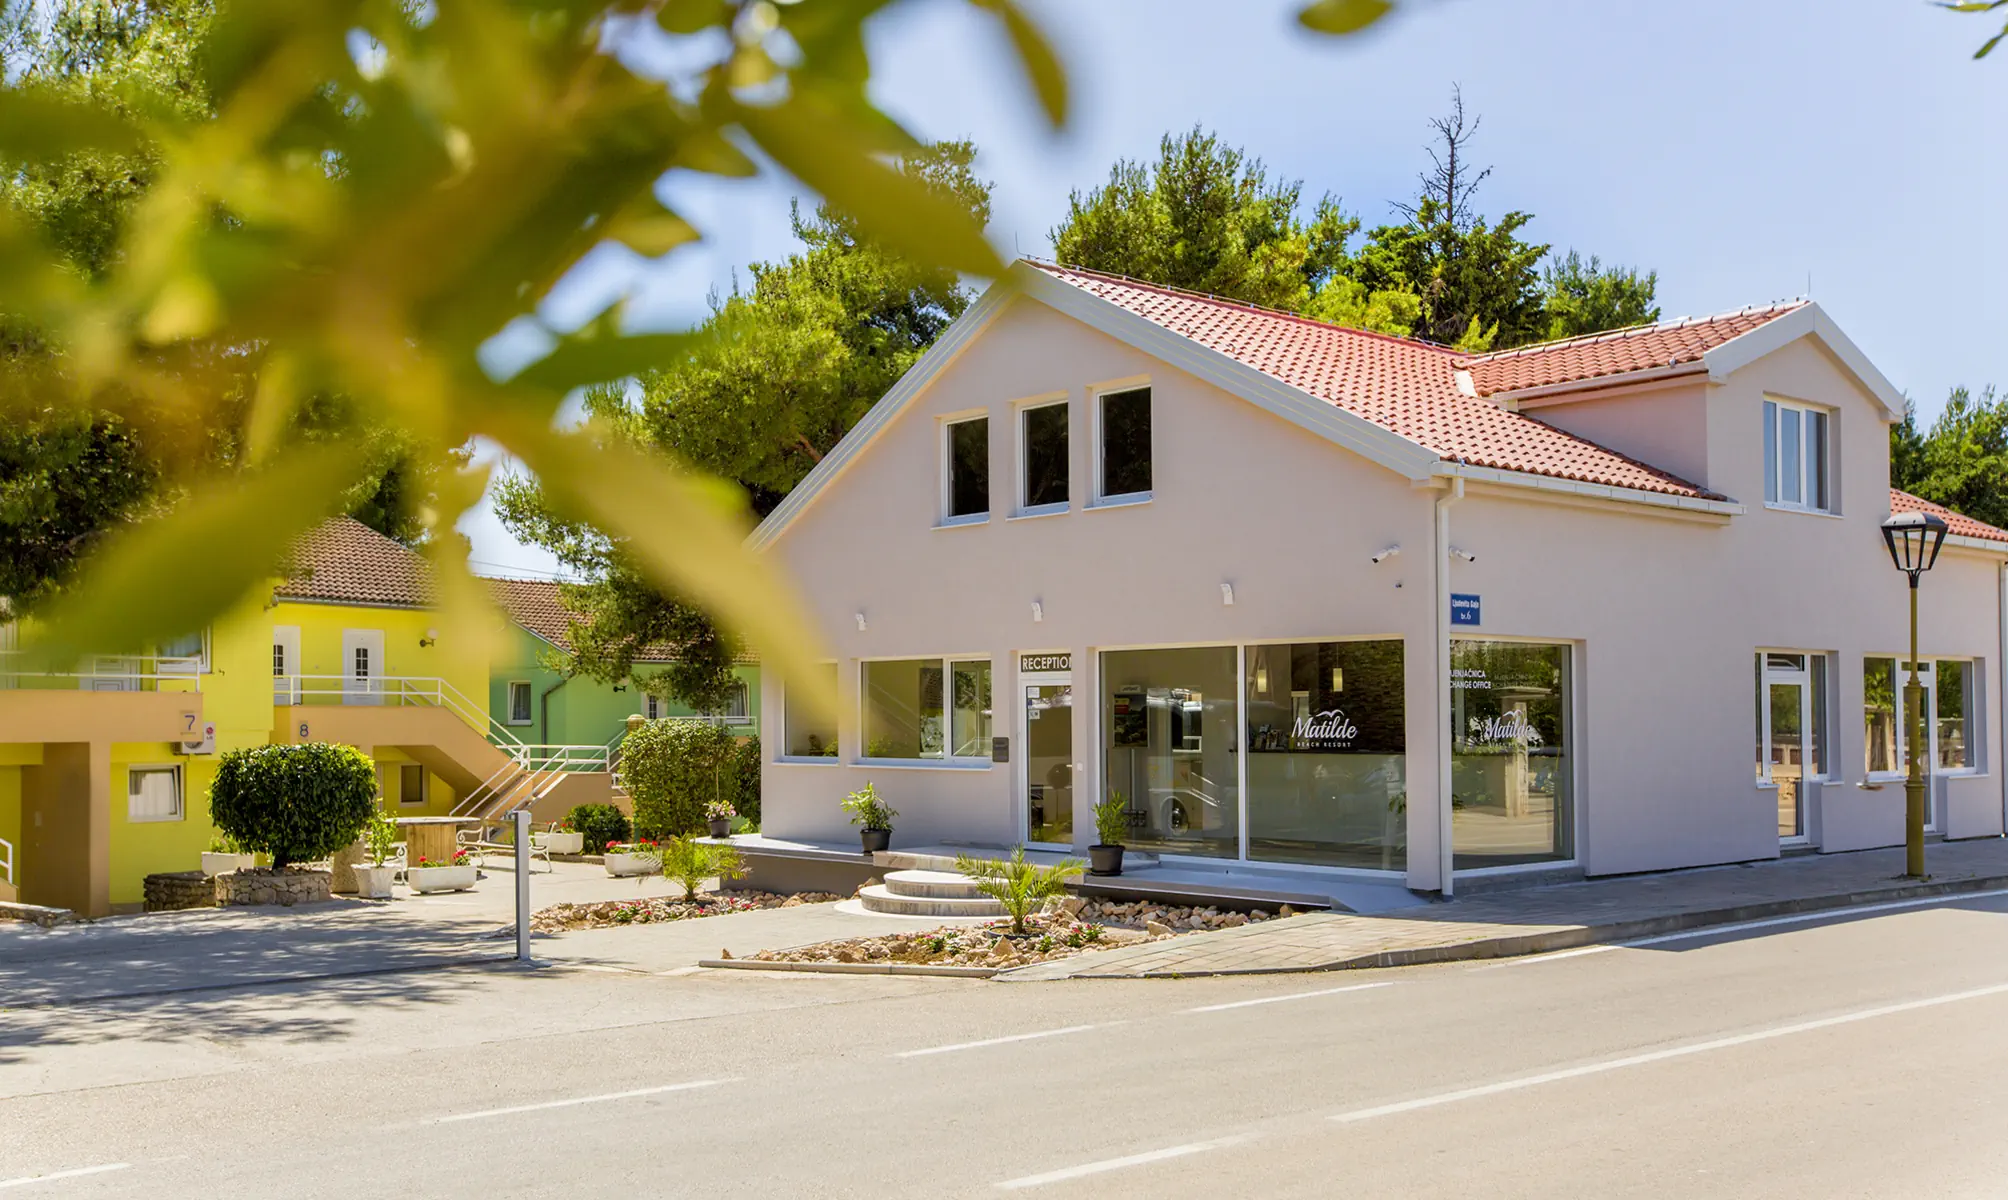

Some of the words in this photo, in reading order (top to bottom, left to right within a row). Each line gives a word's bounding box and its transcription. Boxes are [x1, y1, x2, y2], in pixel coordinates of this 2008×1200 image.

[1449, 668, 1486, 677] JENJAČNICA
[1472, 680, 1491, 689] OFFICE
[184, 714, 196, 731] 7
[1291, 715, 1358, 739] Matilde
[1484, 716, 1531, 739] Matilde
[299, 724, 309, 738] 8
